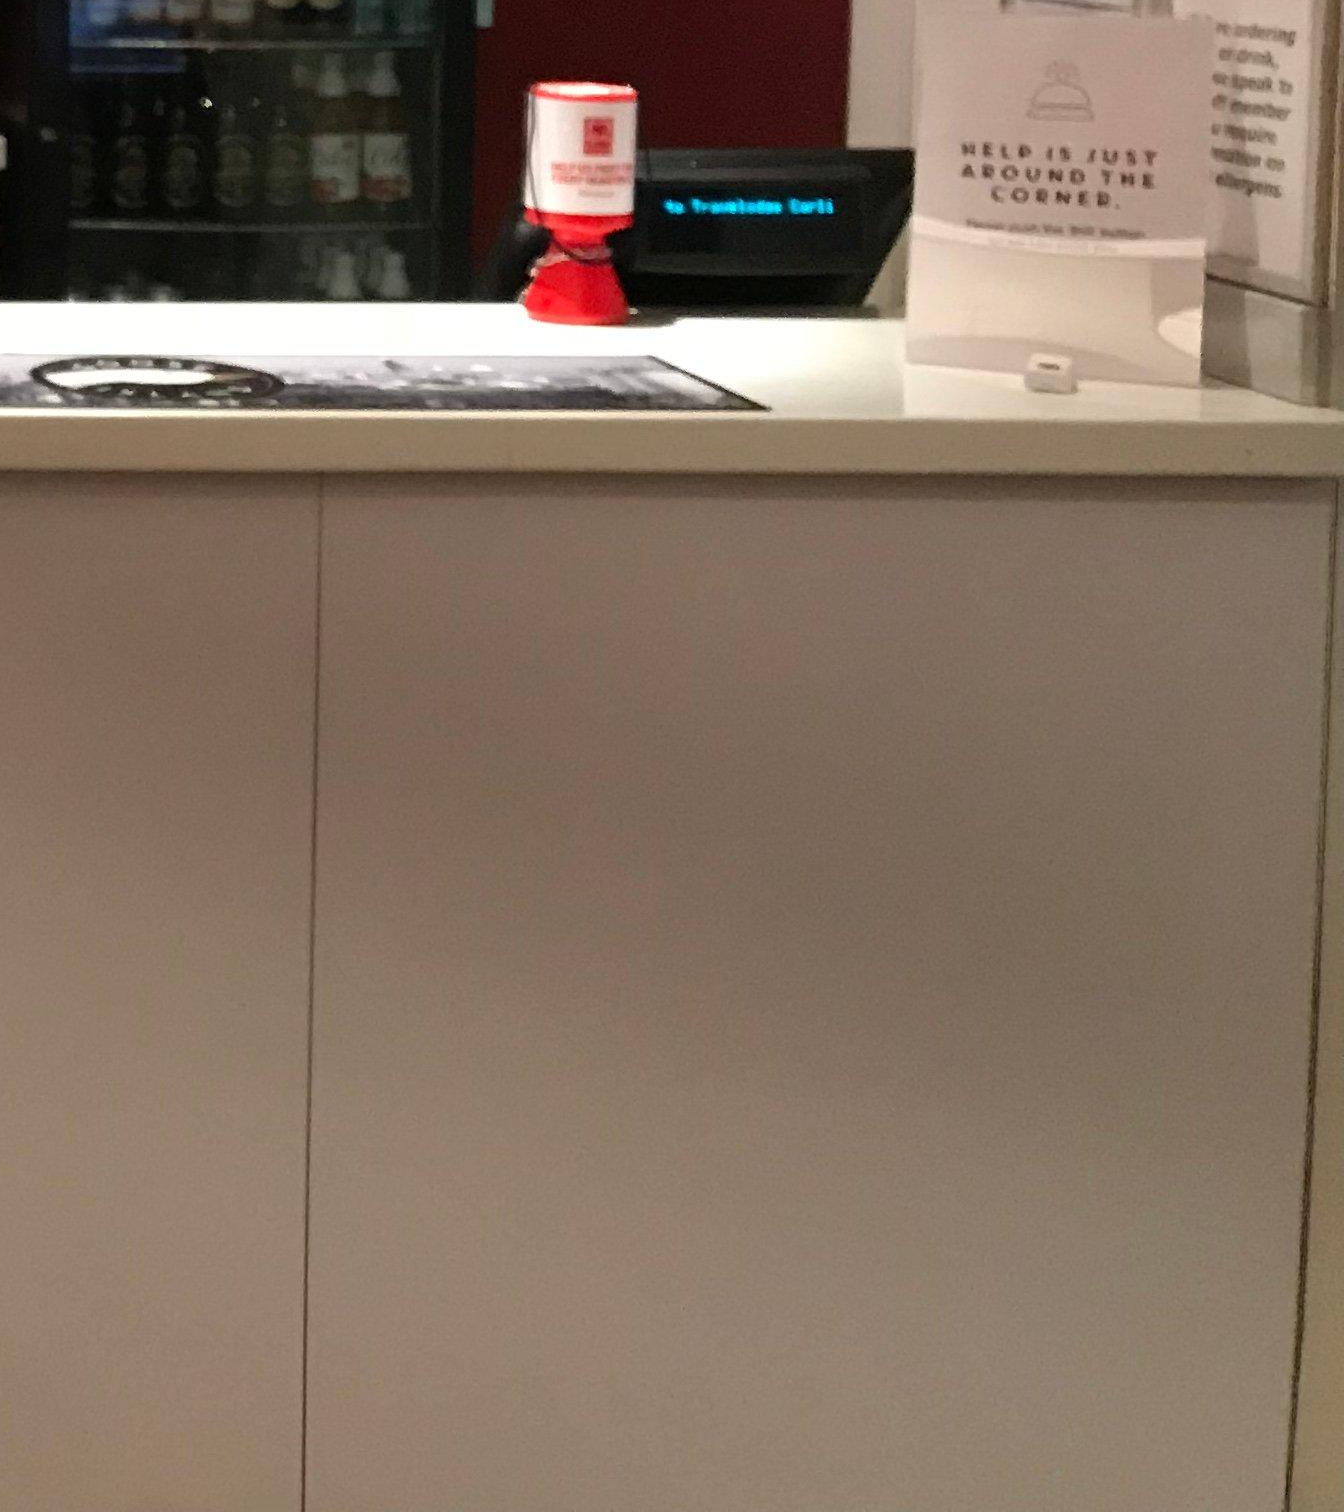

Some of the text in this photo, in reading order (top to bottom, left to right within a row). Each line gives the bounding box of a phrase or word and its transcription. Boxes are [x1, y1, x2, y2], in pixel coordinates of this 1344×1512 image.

[961, 141, 1158, 166] HELP IS JUST
[961, 163, 1156, 189] AROUND THE
[990, 185, 1121, 210] CORNER.
